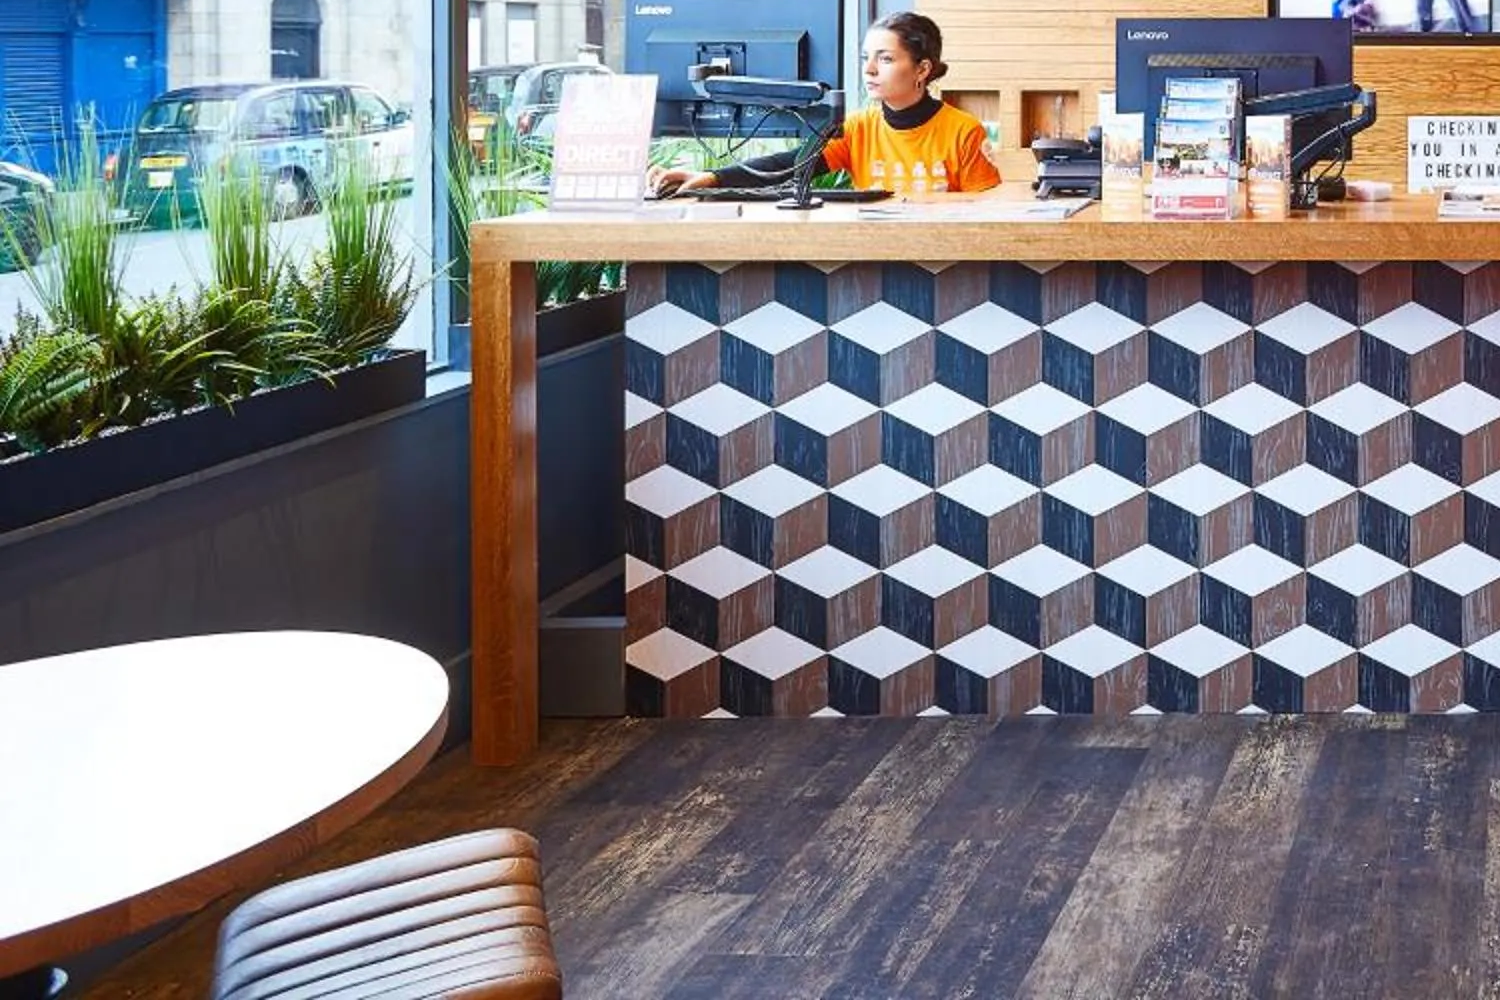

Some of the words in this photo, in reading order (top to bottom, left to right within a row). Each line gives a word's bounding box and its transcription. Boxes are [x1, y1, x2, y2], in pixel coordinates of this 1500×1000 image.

[635, 4, 673, 16] Lenovo
[1127, 29, 1169, 41] Lenovo
[1411, 142, 1441, 157] YOU
[1460, 142, 1477, 157] IN
